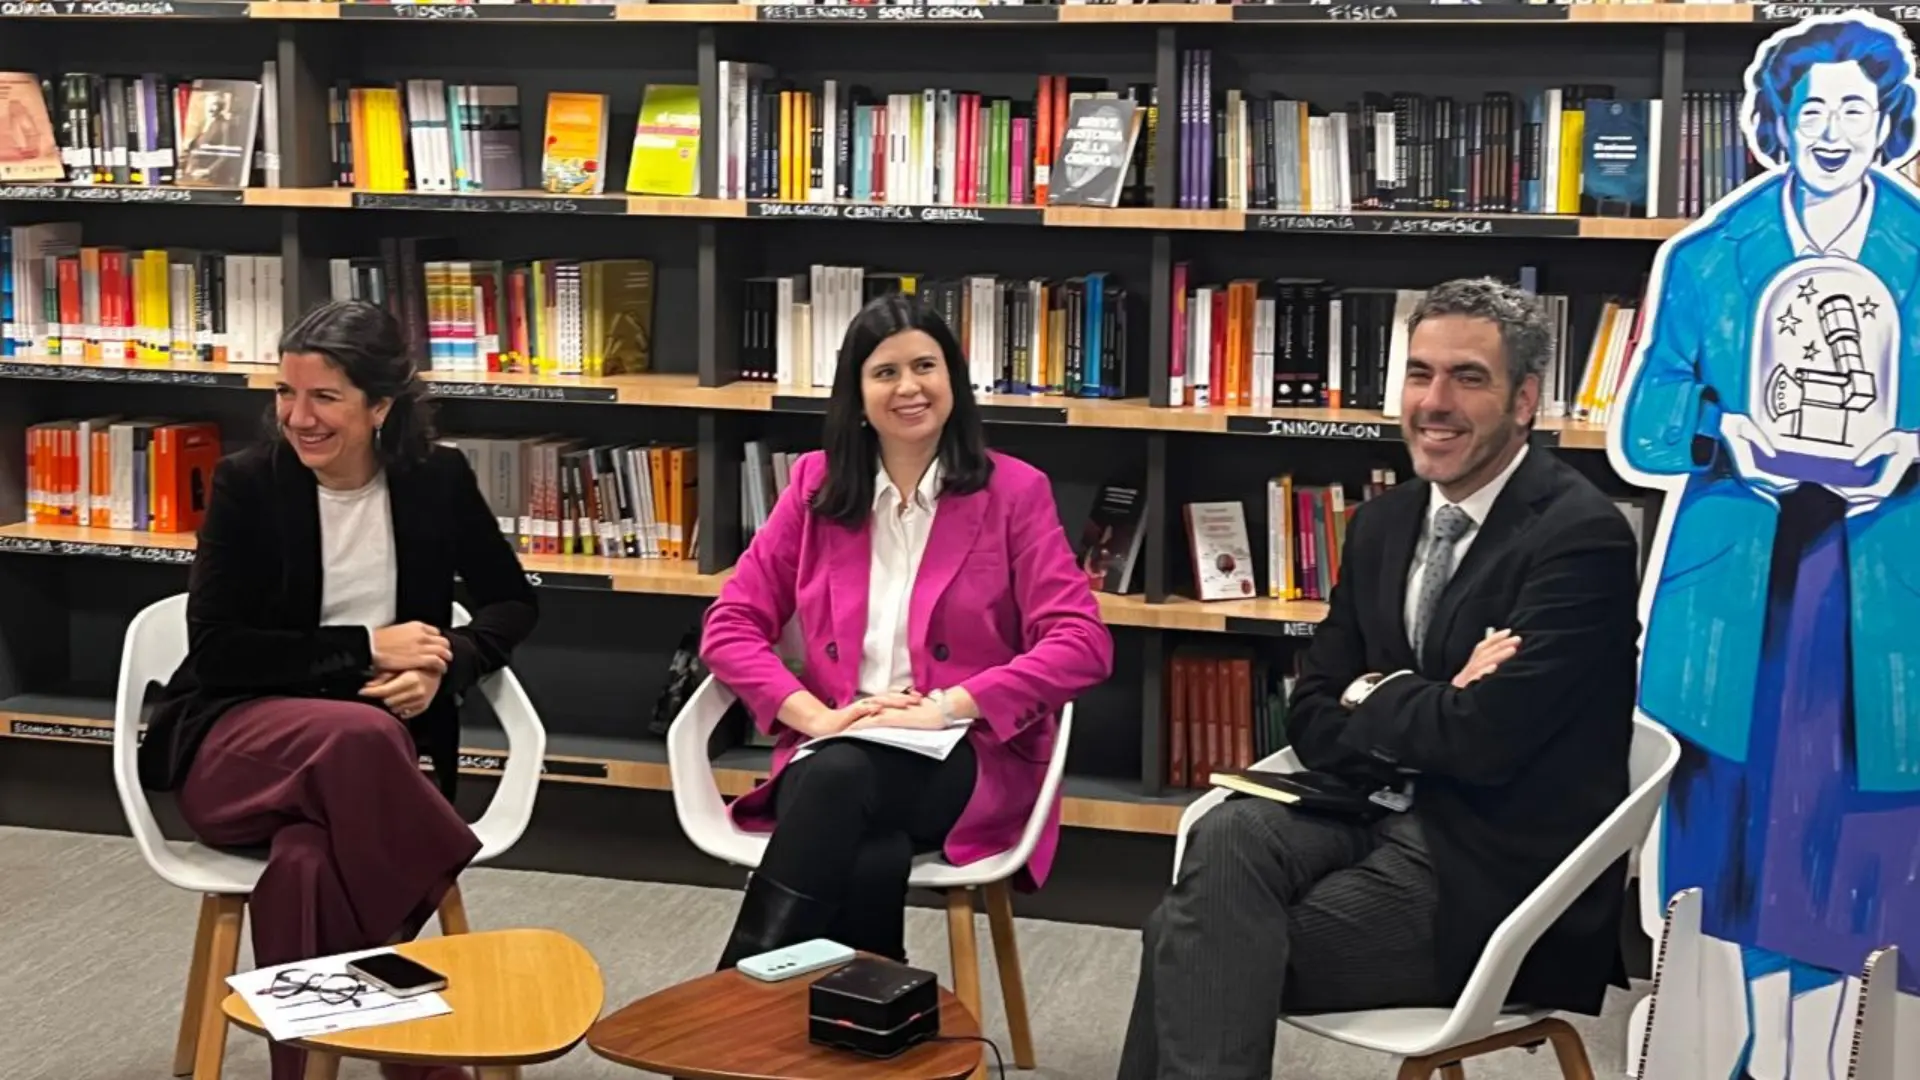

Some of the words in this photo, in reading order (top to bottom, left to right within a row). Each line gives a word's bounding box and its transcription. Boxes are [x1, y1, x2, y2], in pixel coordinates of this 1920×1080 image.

[65, 3, 75, 14] Y
[763, 6, 868, 19] REFLEXIONES
[878, 6, 924, 20] SOBRE
[928, 6, 984, 19] CIENCIA
[921, 206, 984, 220] GENERAL
